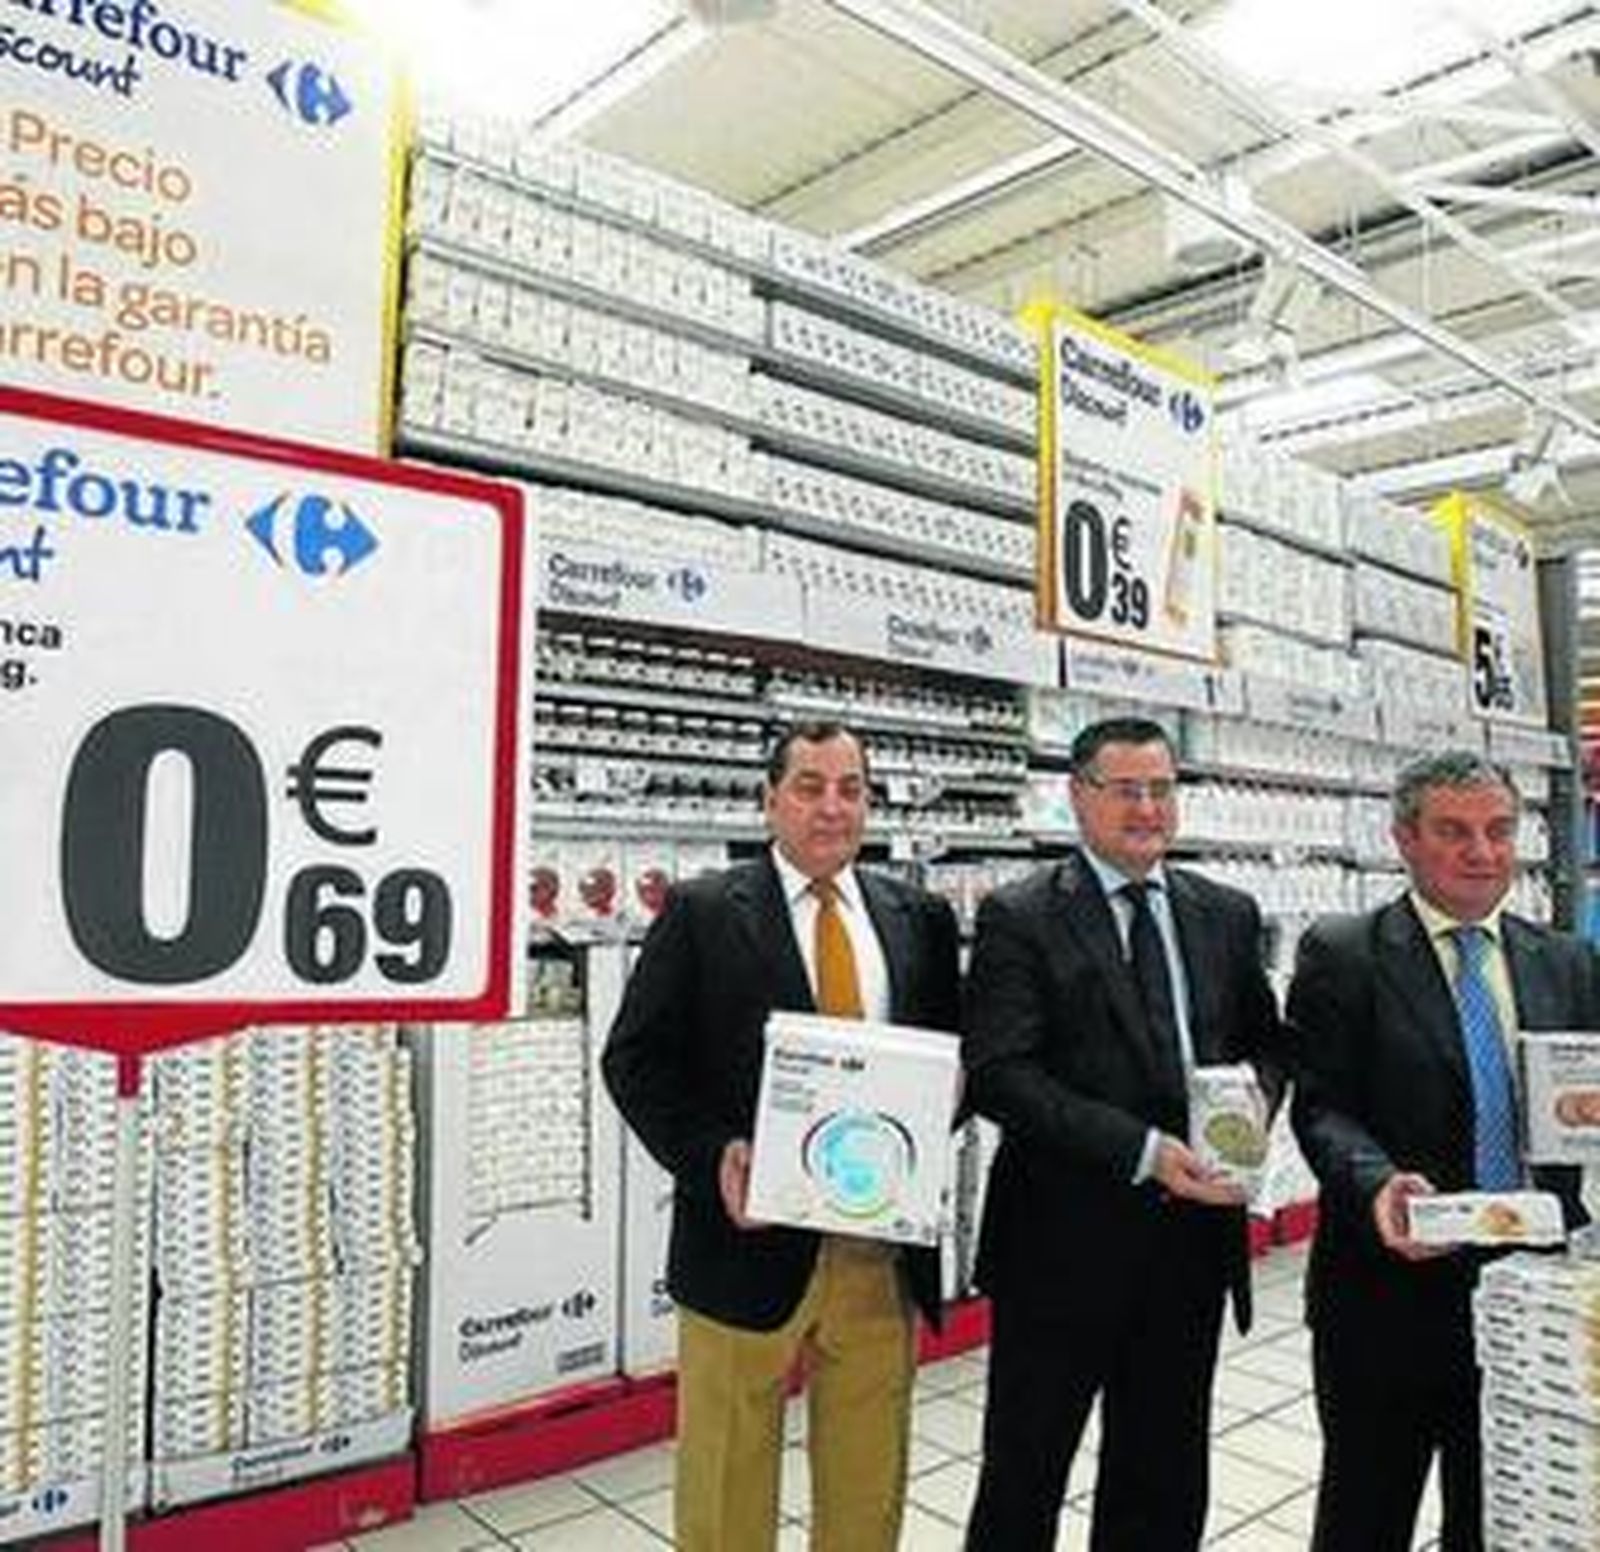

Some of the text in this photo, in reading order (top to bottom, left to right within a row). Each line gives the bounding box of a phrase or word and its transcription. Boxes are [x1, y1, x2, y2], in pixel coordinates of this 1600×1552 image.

[11, 110, 191, 200] Precio
[78, 193, 197, 267] bajo
[61, 252, 105, 306] la
[117, 281, 331, 364] garantía
[0, 322, 221, 399] rrefour.
[1063, 500, 1108, 620] 0
[1112, 517, 1132, 571] €
[1111, 573, 1149, 630] 39
[61, 702, 454, 985] 0 € 69
